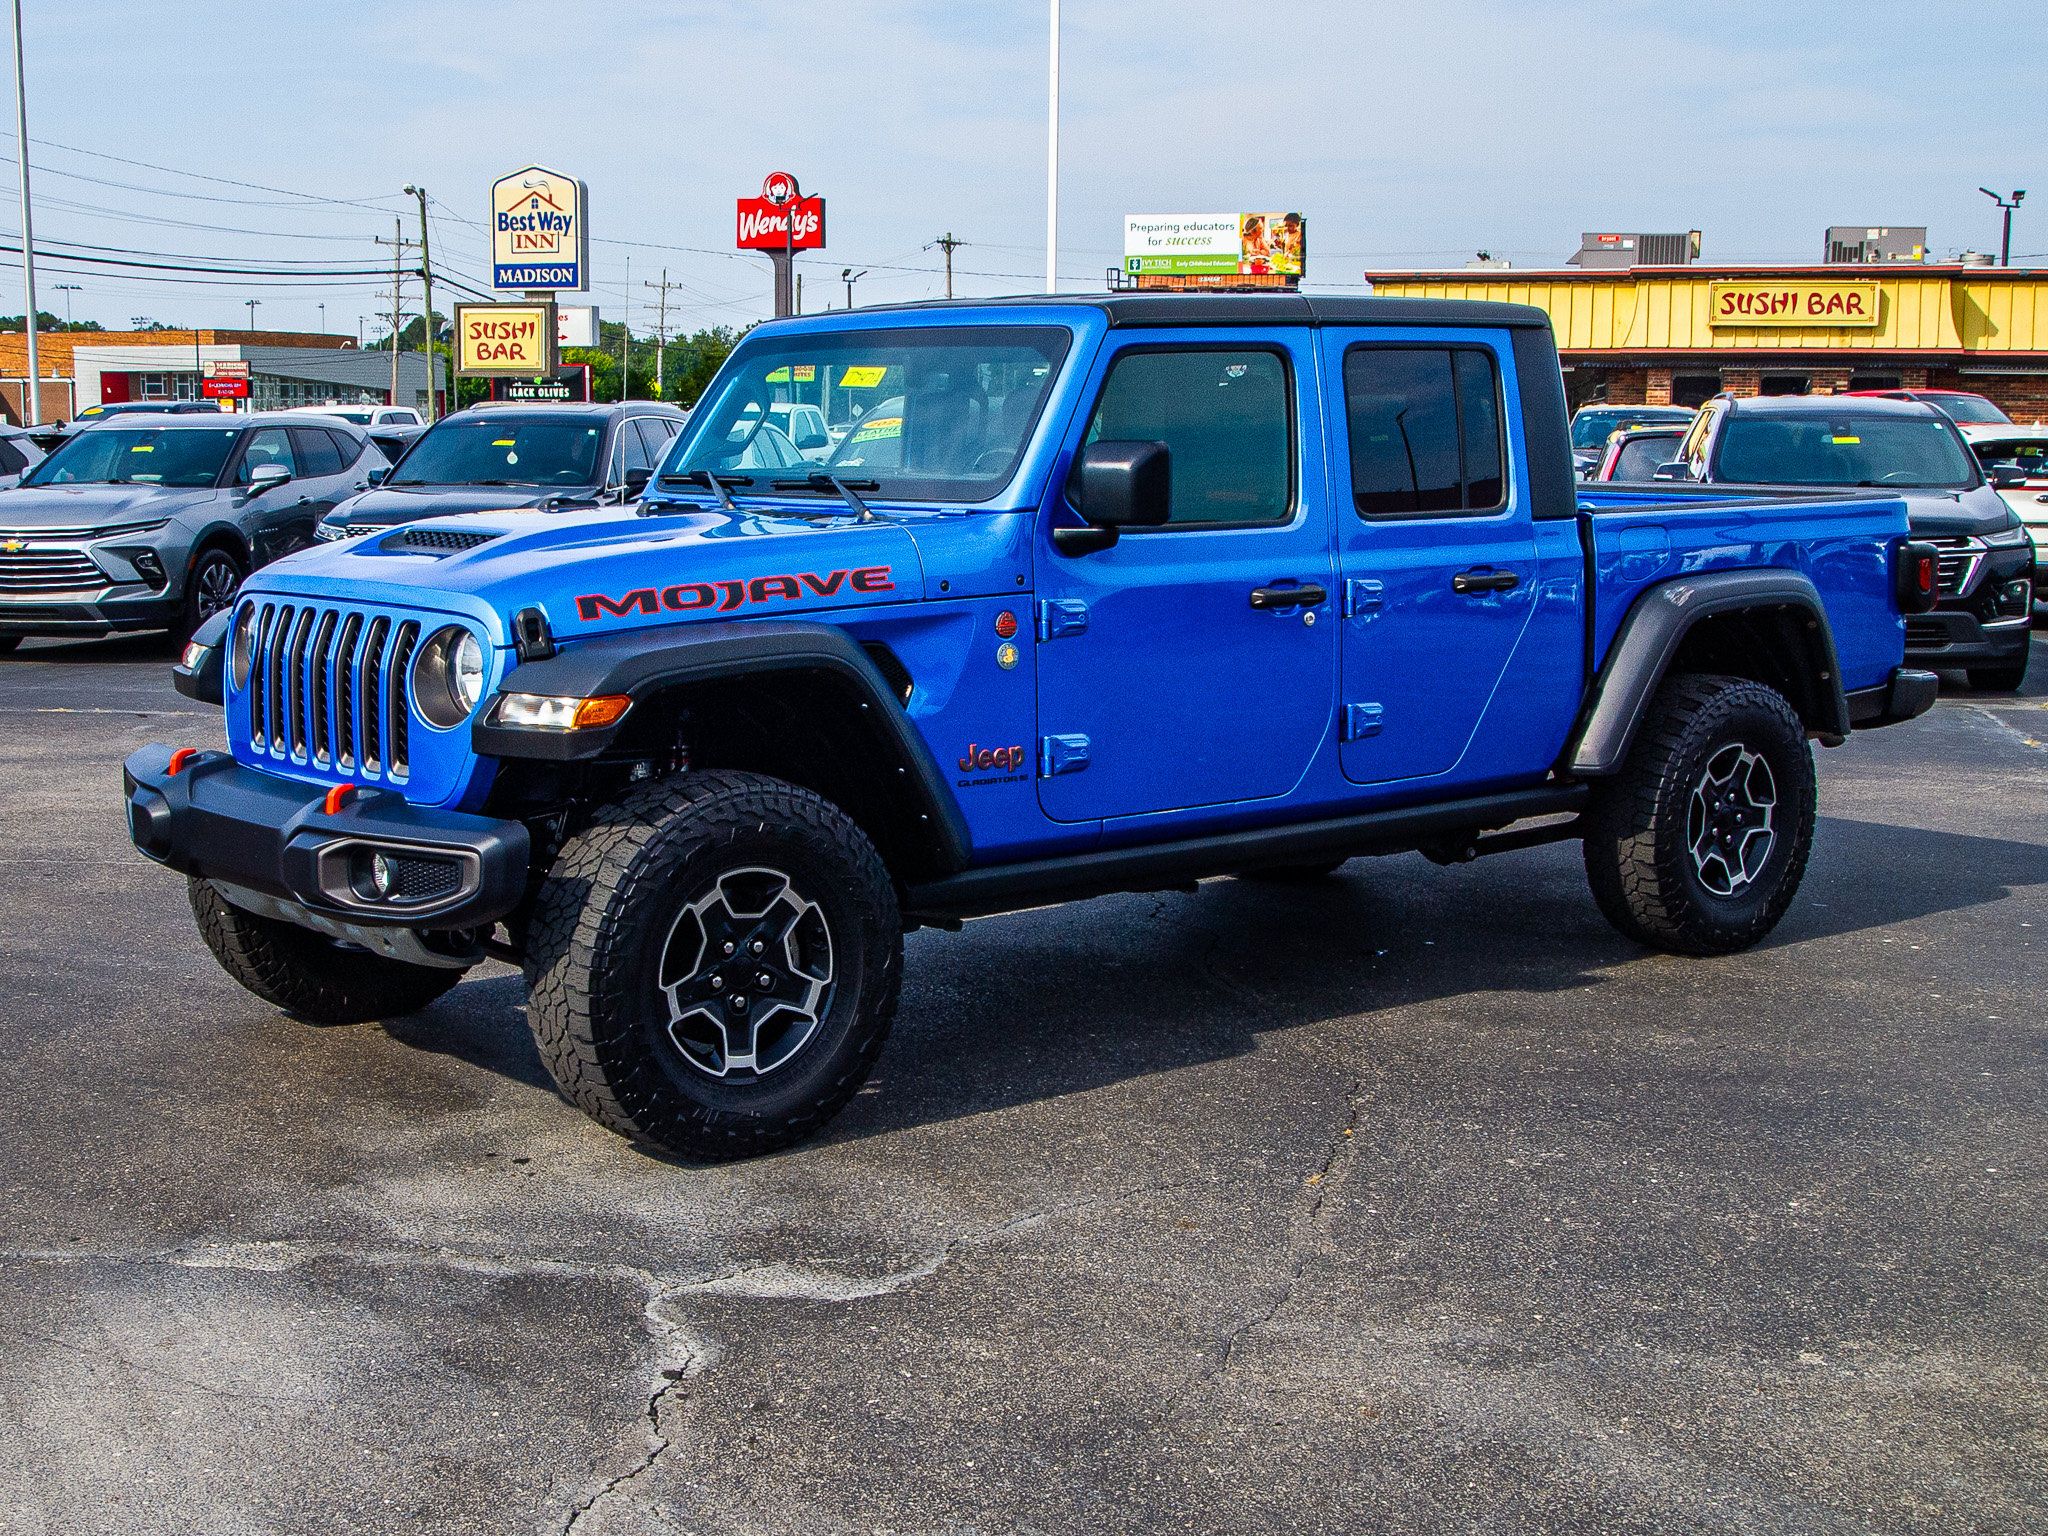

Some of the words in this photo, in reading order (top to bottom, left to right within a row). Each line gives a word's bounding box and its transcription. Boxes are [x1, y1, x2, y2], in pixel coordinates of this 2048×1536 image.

[498, 212, 535, 232] Best
[537, 211, 573, 237] Way
[739, 204, 819, 242] Wendy's
[1130, 222, 1180, 234] Preparing
[1183, 221, 1235, 231] educators
[516, 233, 555, 249] INN
[1148, 236, 1162, 246] for
[1165, 236, 1213, 246] success
[498, 268, 574, 283] MADISON
[1720, 292, 1798, 316] SUSHI
[1807, 292, 1866, 316] BAR
[469, 321, 535, 340] SUSHI
[476, 342, 527, 361] BAR
[537, 387, 570, 397] OLIVES
[575, 566, 895, 621] MOJAVE
[959, 743, 1024, 773] Jeep
